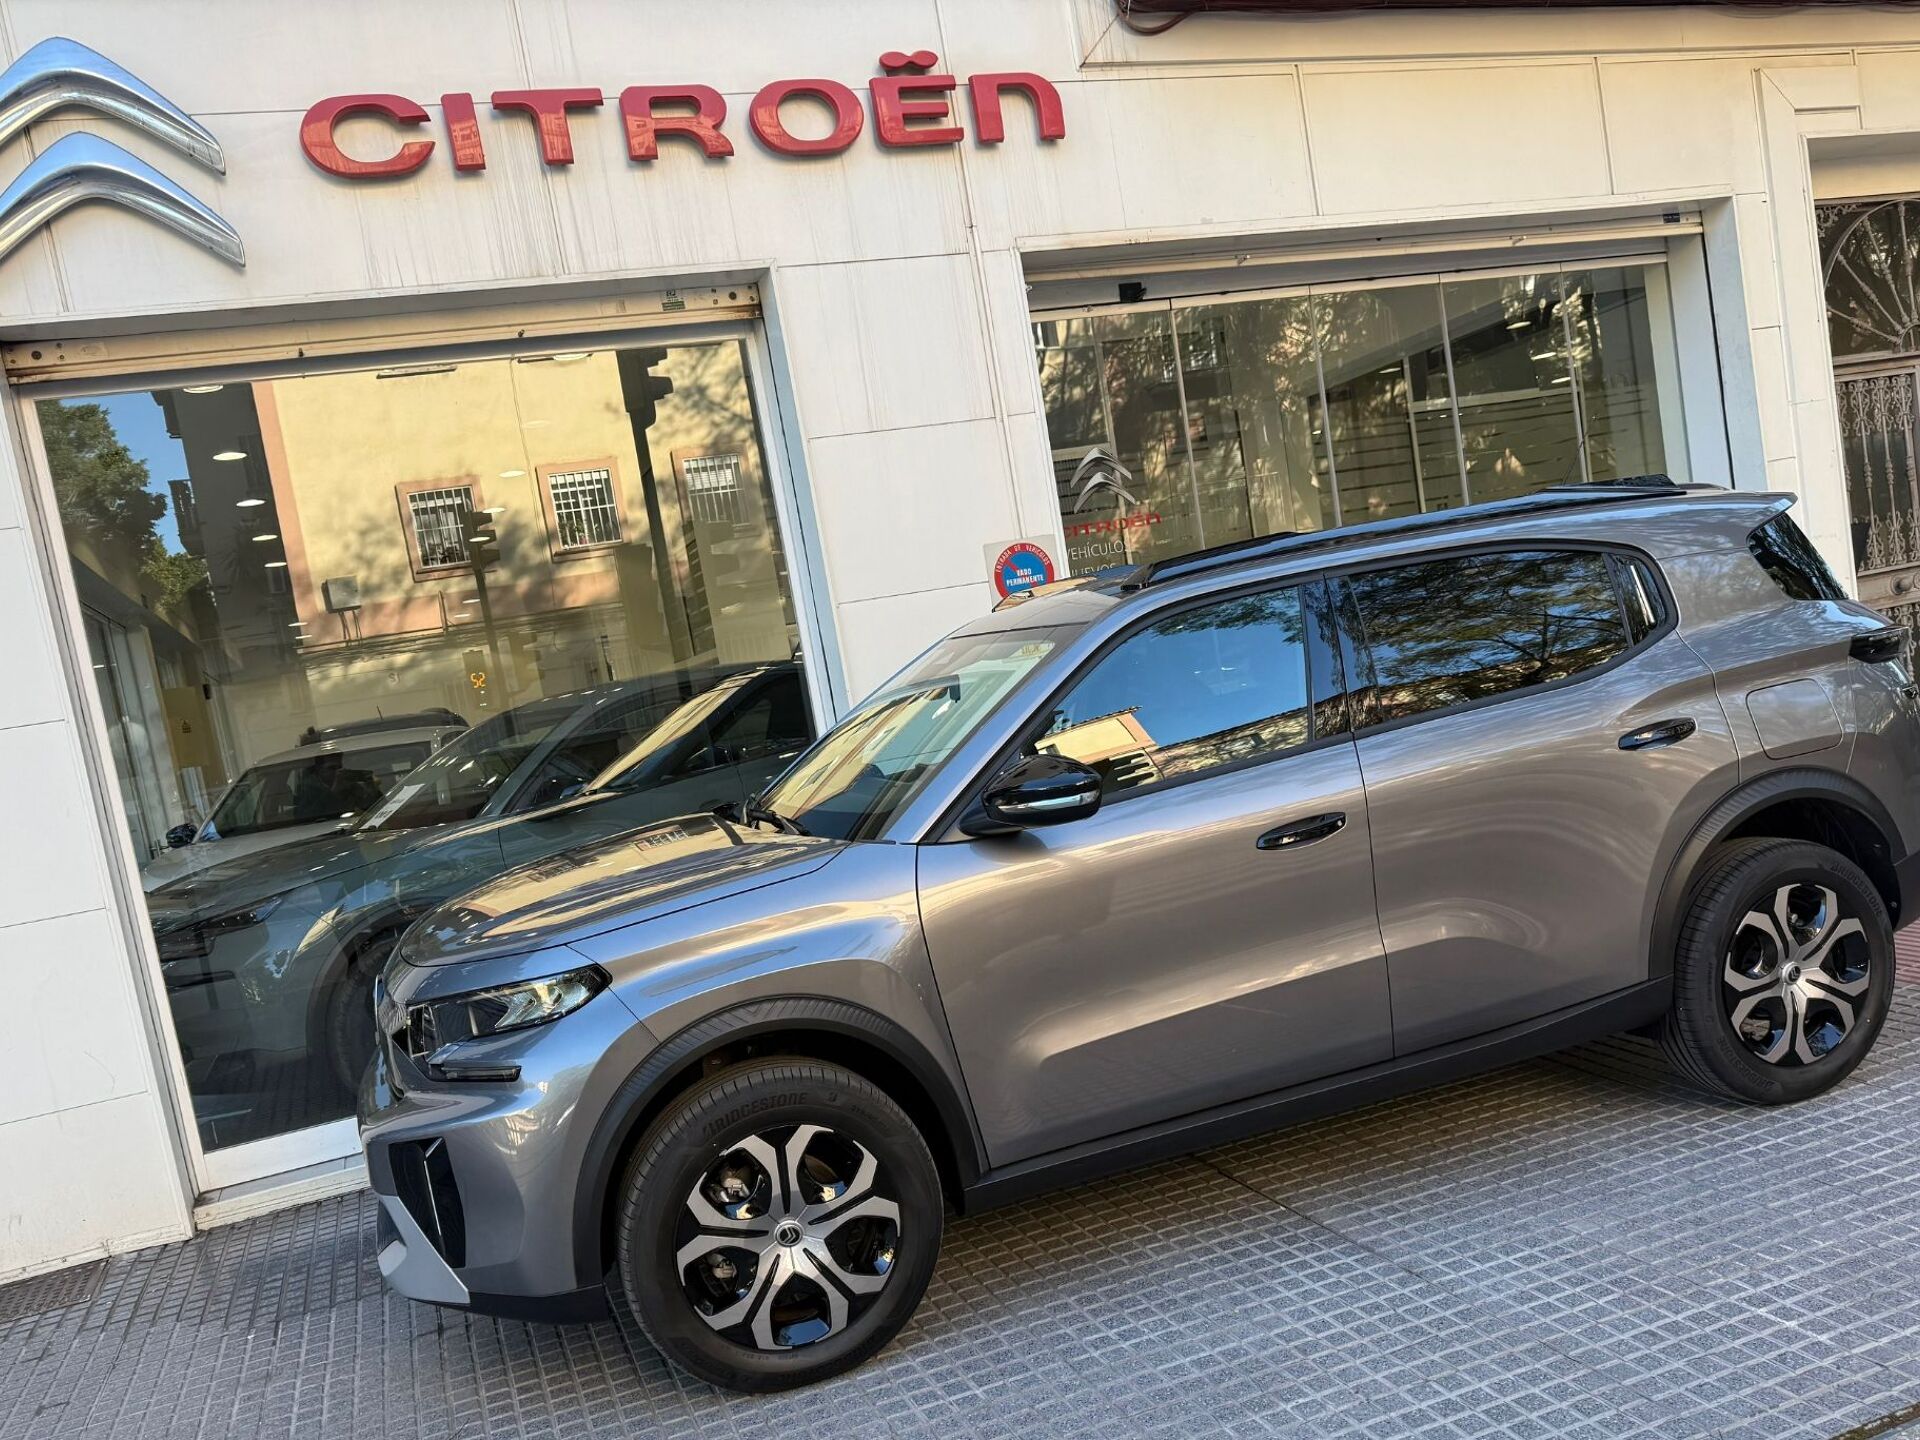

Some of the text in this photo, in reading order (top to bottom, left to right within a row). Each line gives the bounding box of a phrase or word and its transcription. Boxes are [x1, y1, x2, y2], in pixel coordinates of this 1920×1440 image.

[300, 50, 1064, 179] CITROËN
[1016, 568, 1032, 576] VADO
[1006, 574, 1044, 587] PERMANENTE
